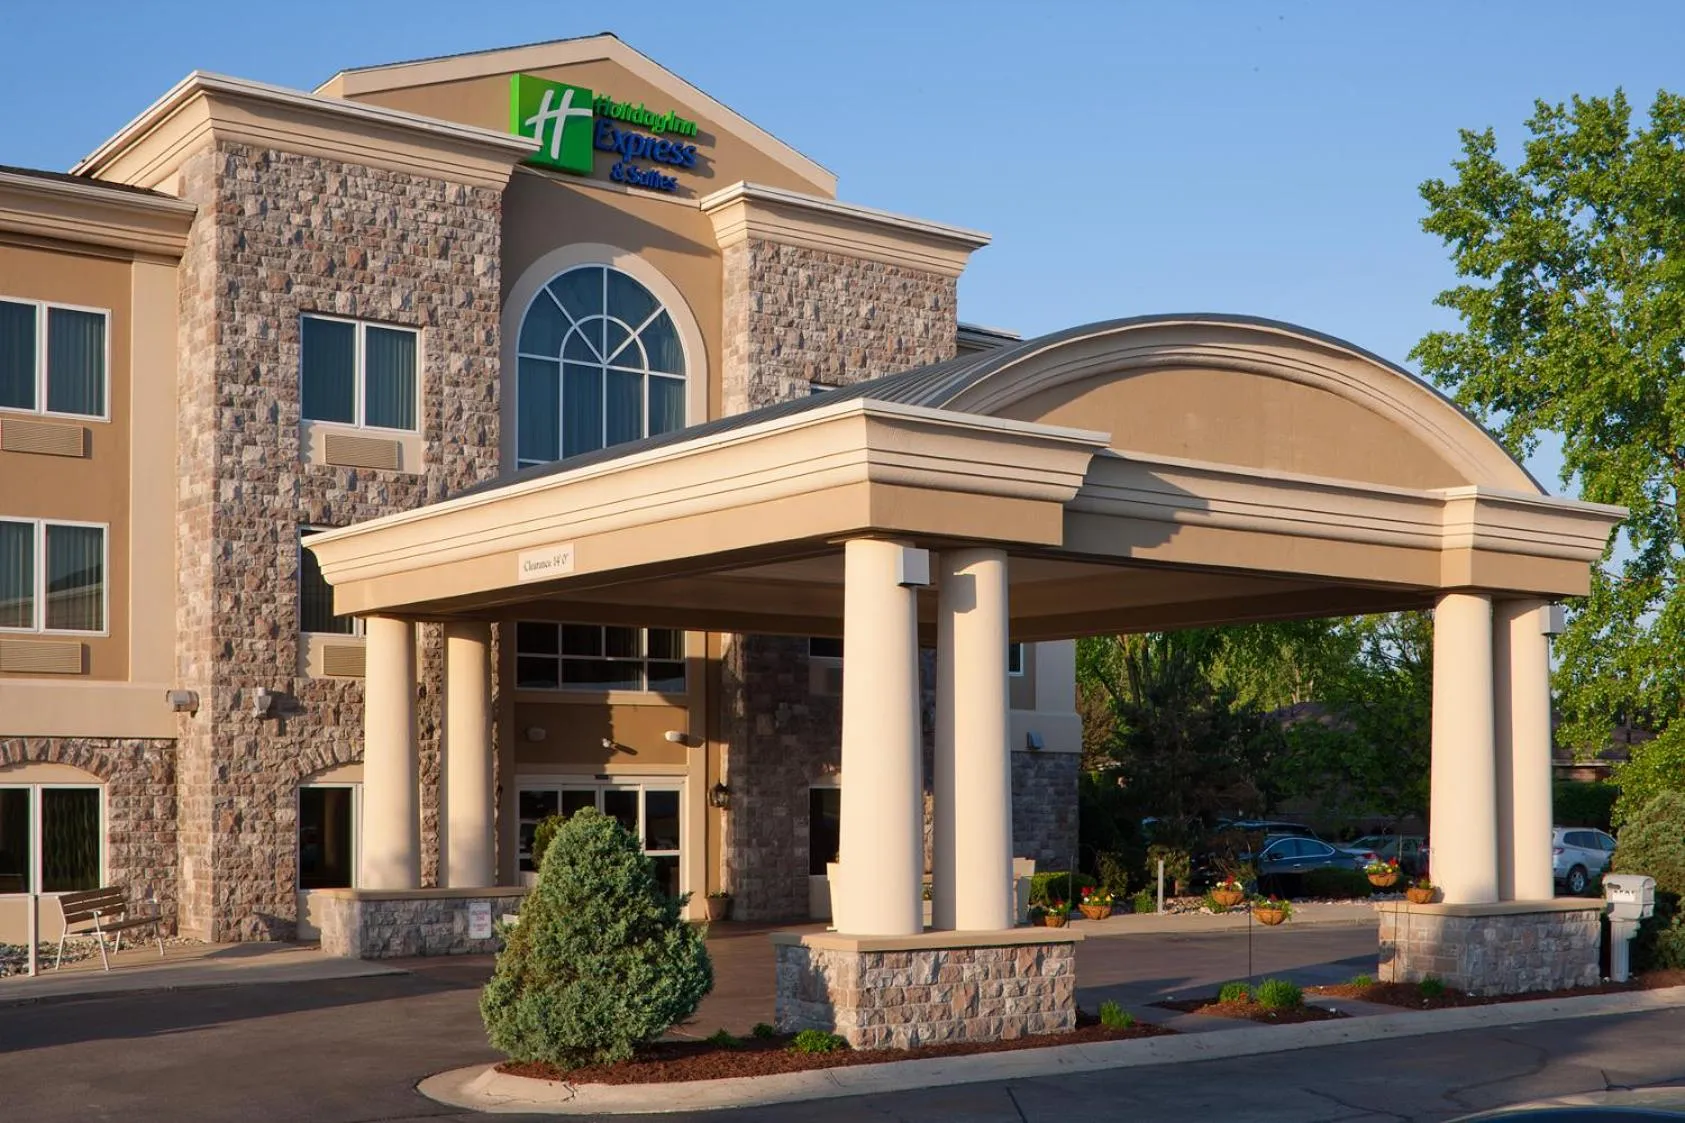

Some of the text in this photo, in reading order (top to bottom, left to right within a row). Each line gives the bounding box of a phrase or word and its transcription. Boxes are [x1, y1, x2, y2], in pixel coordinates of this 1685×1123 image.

[593, 94, 698, 137] Holiday Inn
[593, 117, 697, 168] Express
[609, 160, 679, 192] & Suites
